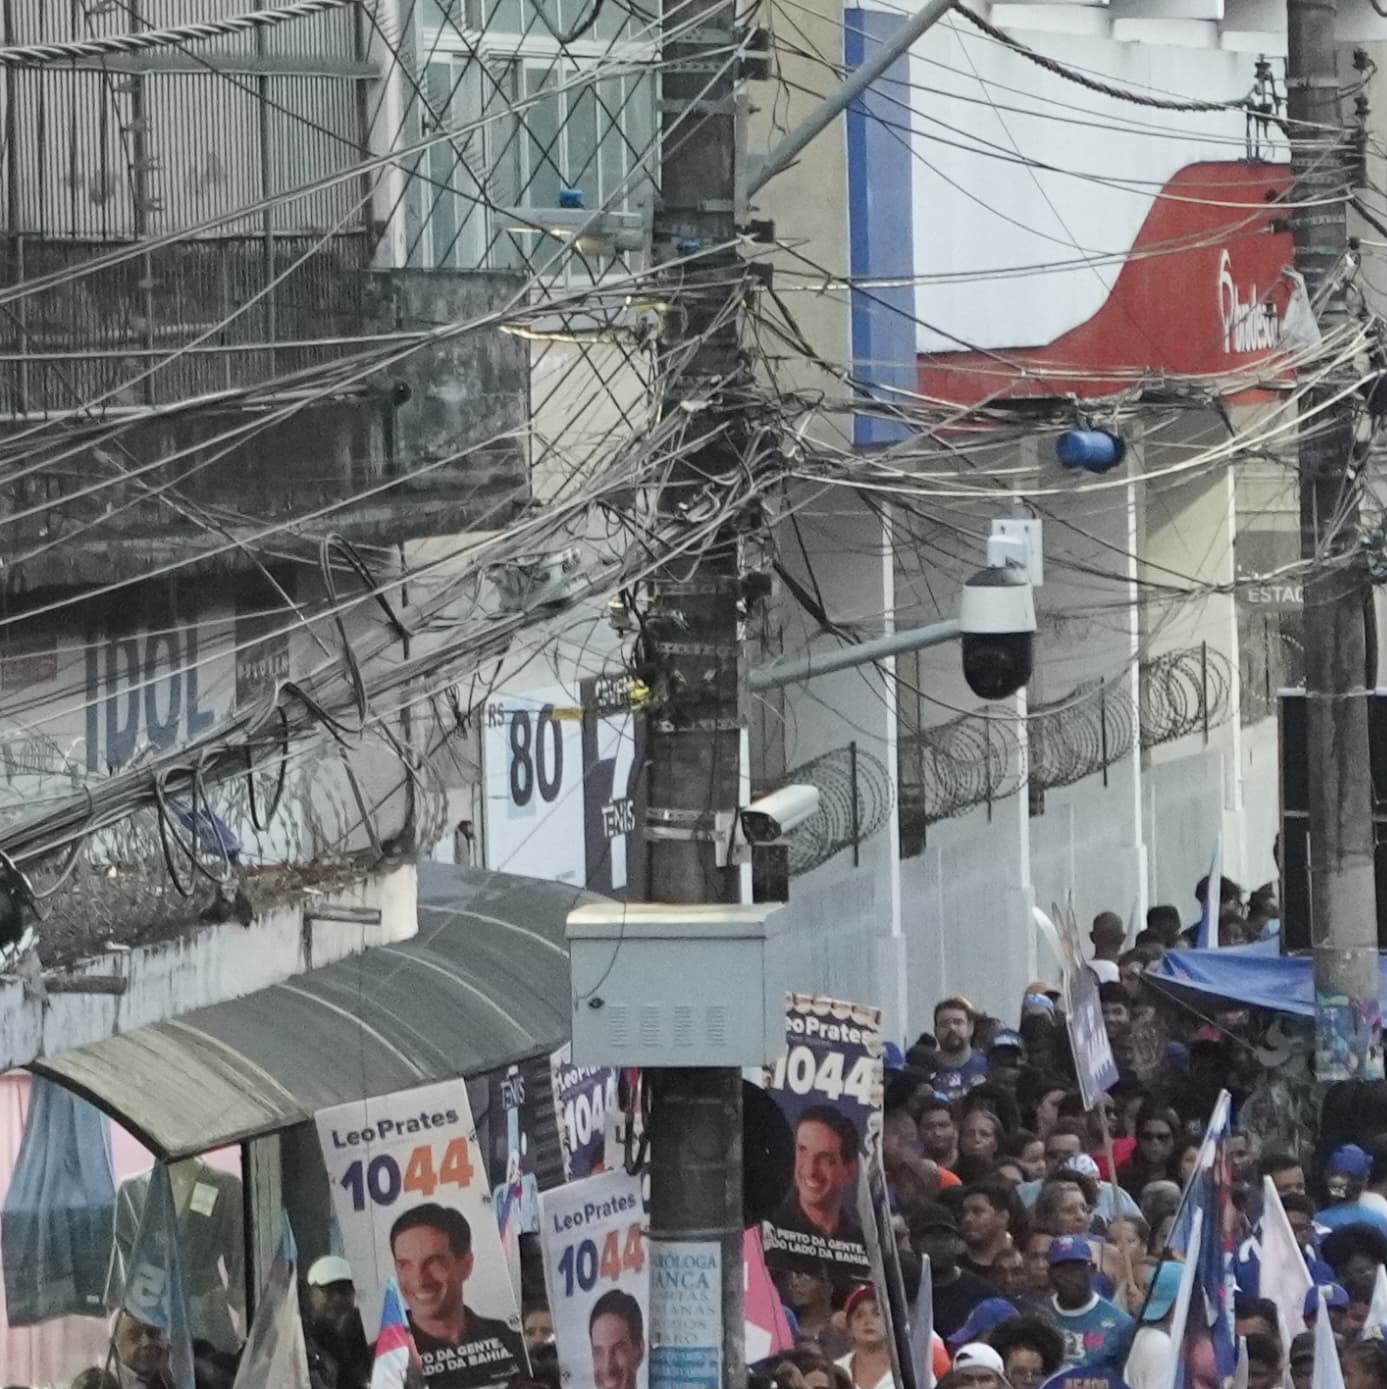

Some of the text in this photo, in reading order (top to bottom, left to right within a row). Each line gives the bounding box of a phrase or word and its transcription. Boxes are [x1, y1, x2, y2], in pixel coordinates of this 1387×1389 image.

[510, 703, 564, 808] 80
[340, 1136, 475, 1212] 1044
[558, 1222, 646, 1298] 1044
